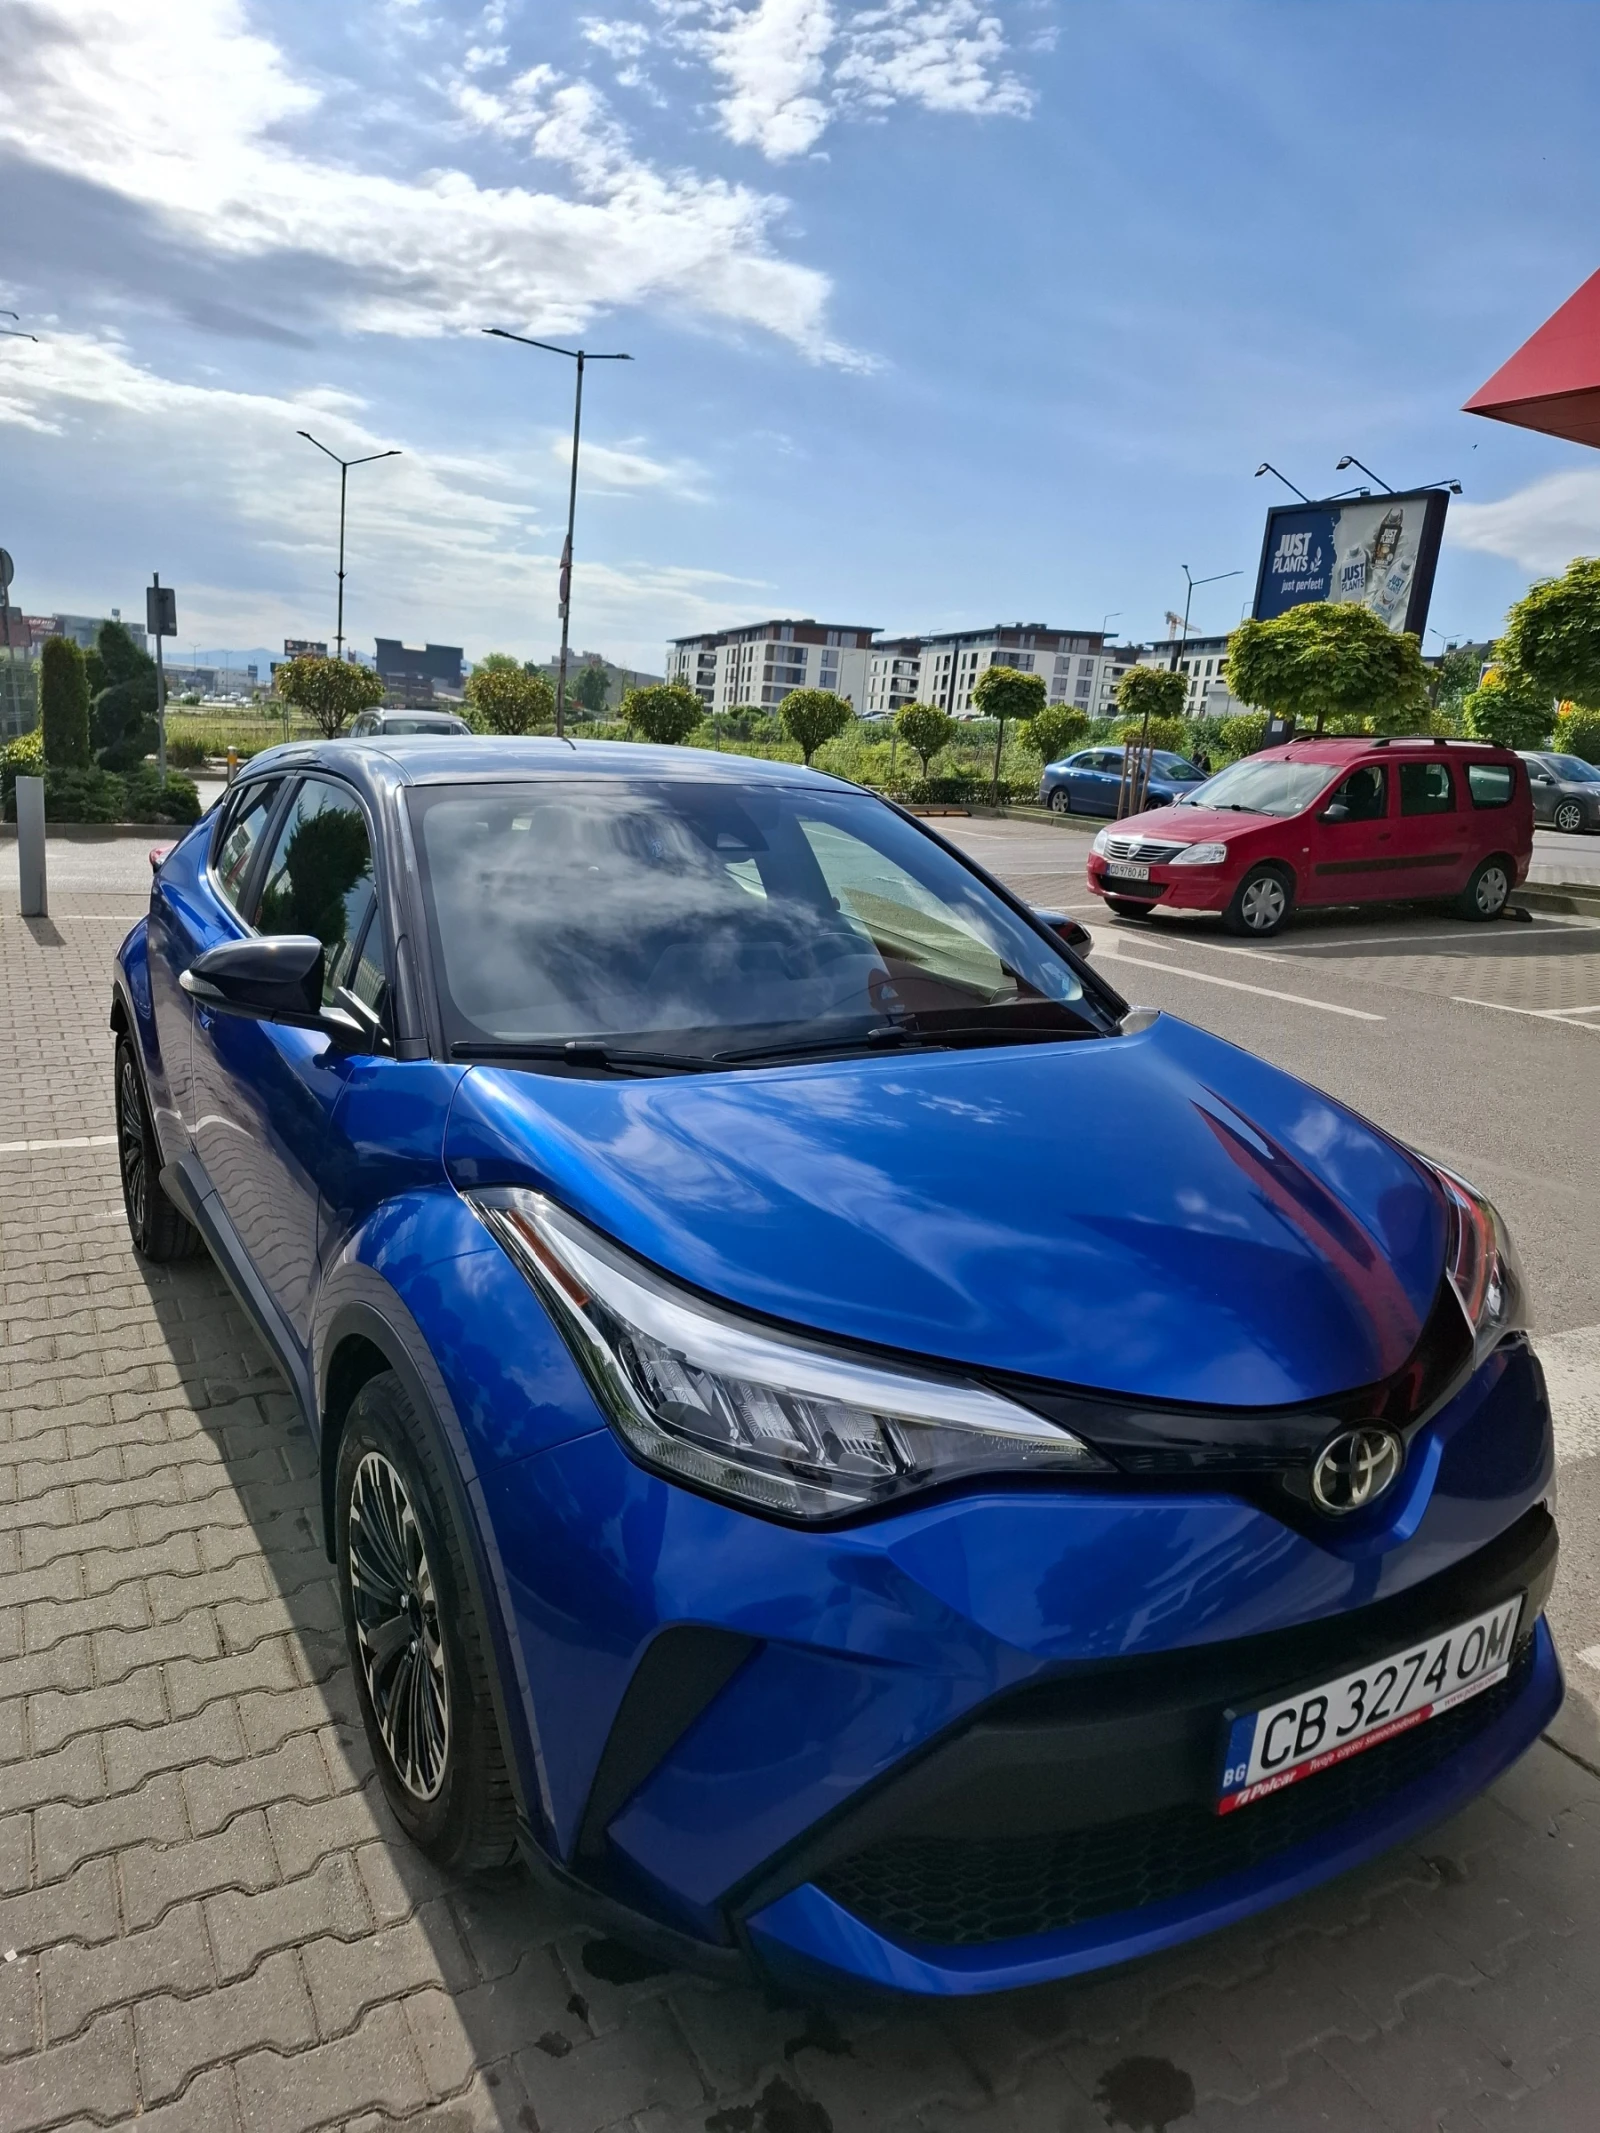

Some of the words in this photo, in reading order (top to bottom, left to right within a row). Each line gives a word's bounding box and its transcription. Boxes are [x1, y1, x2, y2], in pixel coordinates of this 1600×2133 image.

[1275, 532, 1312, 558] JUST
[1272, 555, 1309, 573] PLANTS
[1342, 563, 1365, 583] JUST
[1280, 579, 1295, 594] just
[1295, 577, 1324, 593] perfect!
[1341, 578, 1365, 593] PLANTS
[1260, 1695, 1329, 1769] CB
[1336, 1638, 1452, 1737] 3274
[1457, 1607, 1513, 1680] OM
[1222, 1763, 1247, 1788] BG
[1250, 1771, 1297, 1800] Polcar
